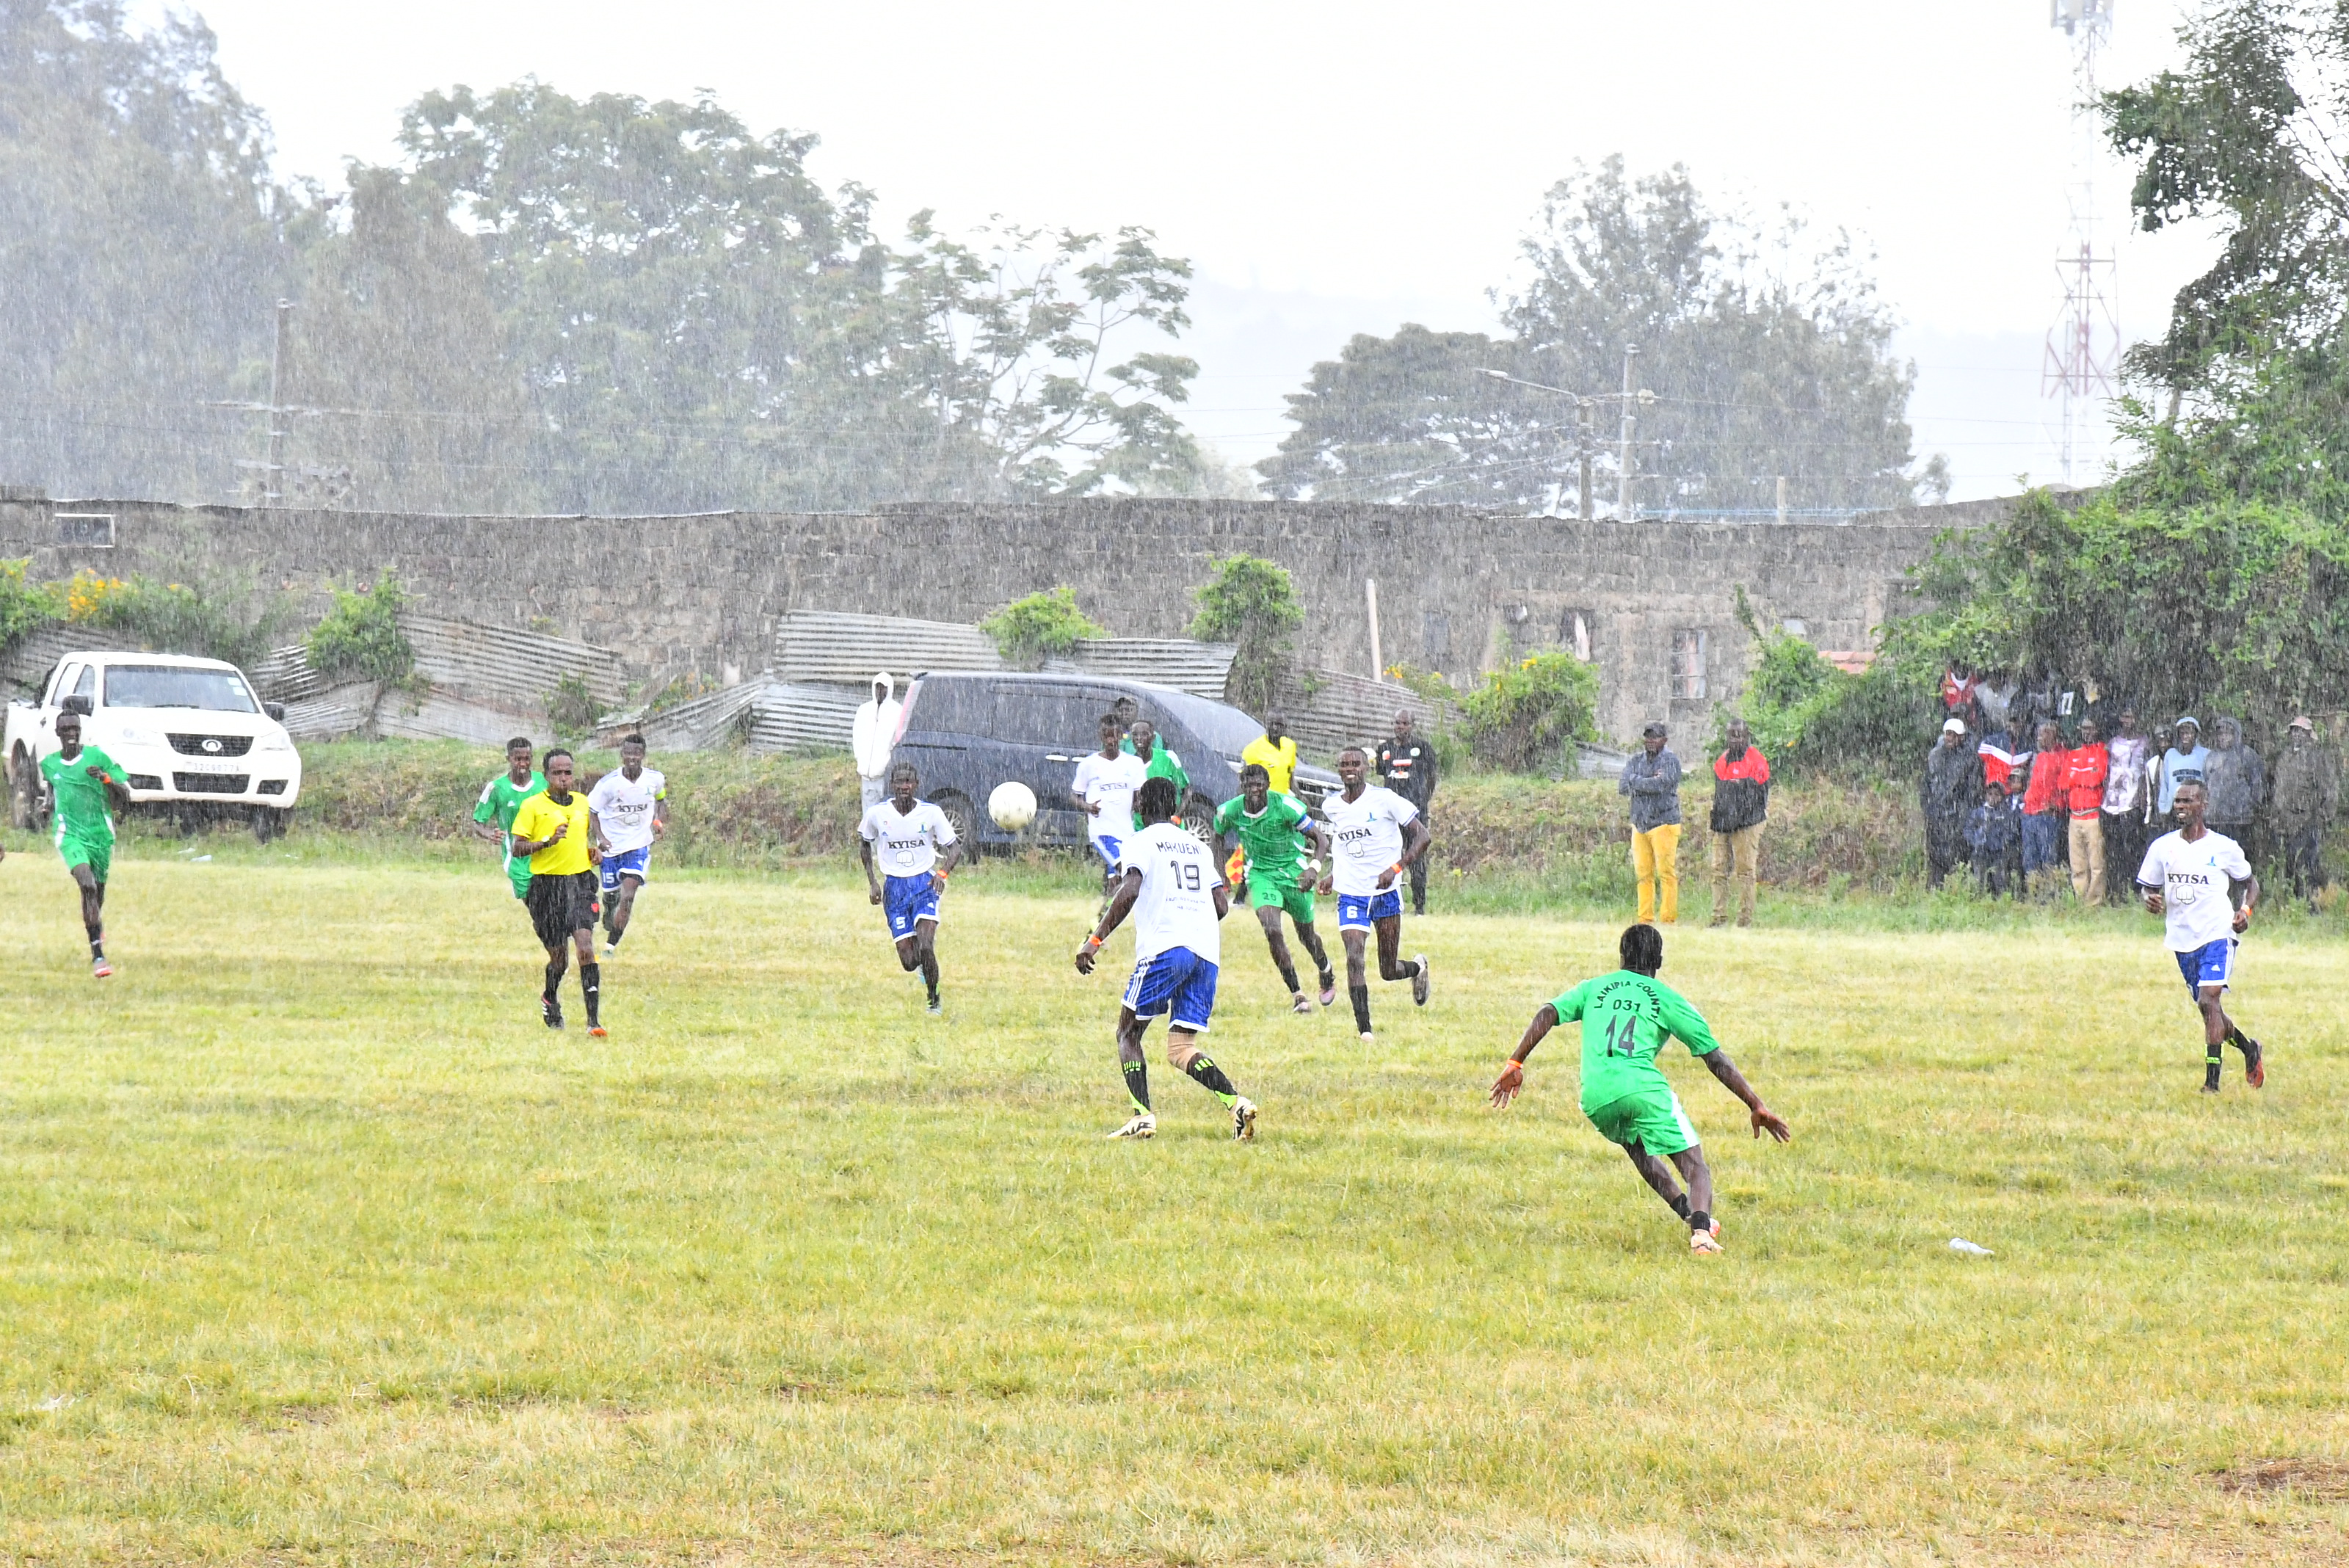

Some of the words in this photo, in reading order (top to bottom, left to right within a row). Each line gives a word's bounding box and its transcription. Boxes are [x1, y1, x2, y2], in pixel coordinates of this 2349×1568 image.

[1337, 828, 1372, 841] KYISA
[887, 839, 926, 849] KYISA
[603, 872, 615, 884] 15
[1169, 860, 1201, 892] 19
[2167, 873, 2210, 885] KYISA
[1346, 905, 1358, 919] 6
[896, 917, 906, 929] 5
[1594, 981, 1631, 1009] LAIKIPIA
[1636, 982, 1660, 1021] COUNTY
[1613, 999, 1641, 1012] 031
[1605, 1015, 1637, 1058] 14
